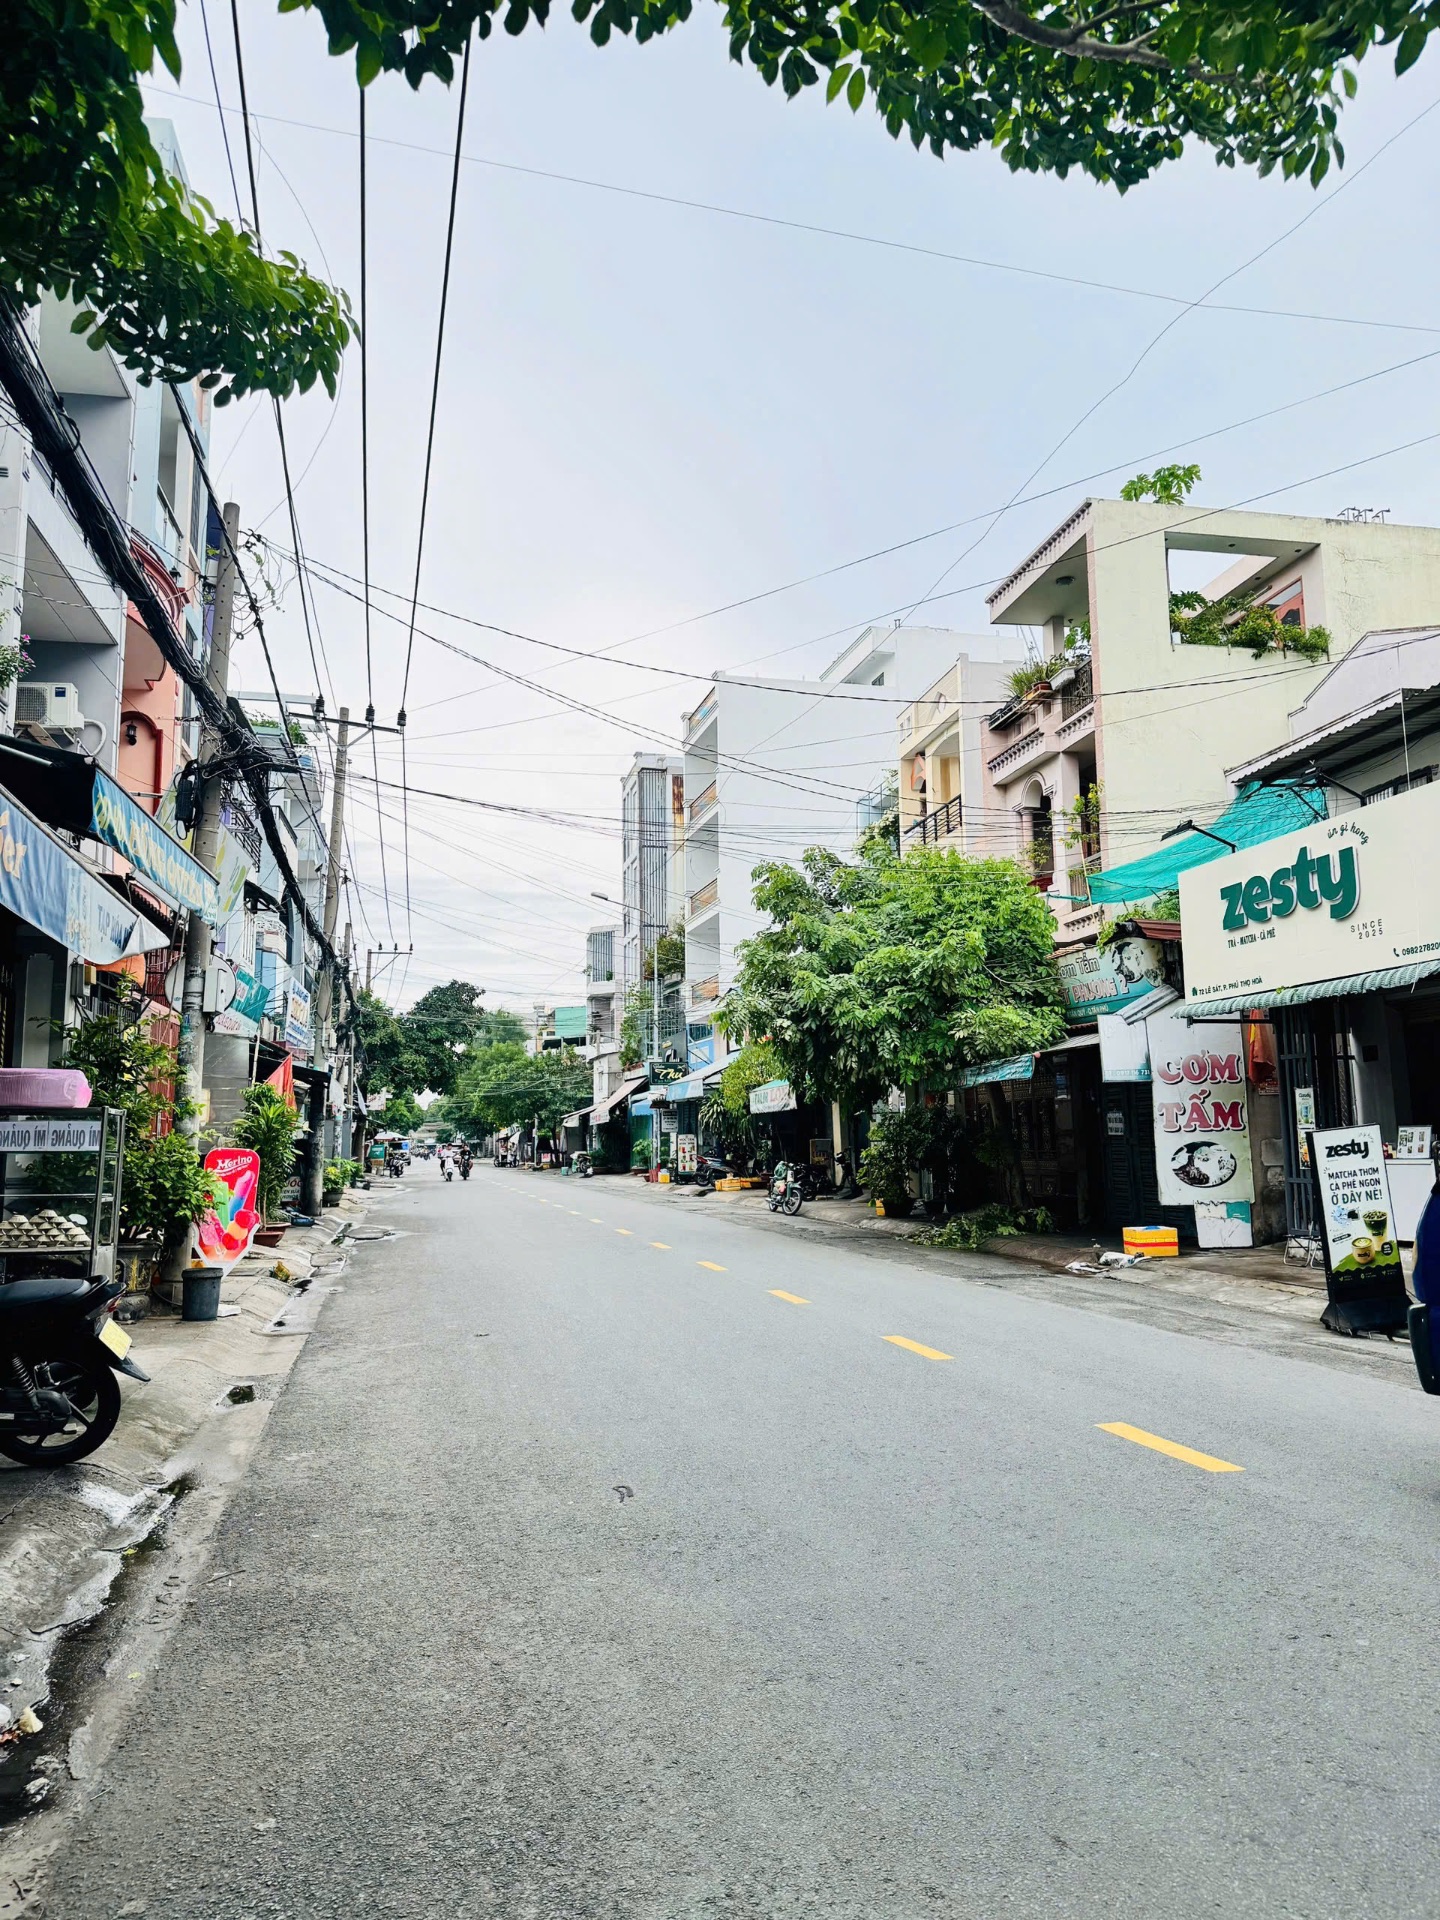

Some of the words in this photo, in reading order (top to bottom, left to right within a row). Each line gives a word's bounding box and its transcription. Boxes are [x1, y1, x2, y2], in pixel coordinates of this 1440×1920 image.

[1219, 846, 1359, 931] zesty
[1350, 918, 1383, 933] SINCE
[1239, 933, 1257, 946] MATCHA
[1358, 927, 1384, 940] 2025
[1401, 941, 1440, 956] 098227820
[1117, 973, 1129, 995] 2
[1198, 988, 1205, 996] 72
[1156, 1049, 1242, 1085] CƠM
[1157, 1088, 1245, 1133] TẤM
[1325, 1138, 1370, 1159] zesty
[216, 1155, 253, 1170] Merino
[1328, 1169, 1358, 1181] MATCHA
[1358, 1166, 1380, 1177] THƠM
[1329, 1181, 1341, 1192] CÀ
[1341, 1179, 1358, 1191] PHÊ
[1358, 1177, 1381, 1188] NGON
[1331, 1192, 1339, 1206] Ở
[1341, 1191, 1363, 1205] ĐÂY
